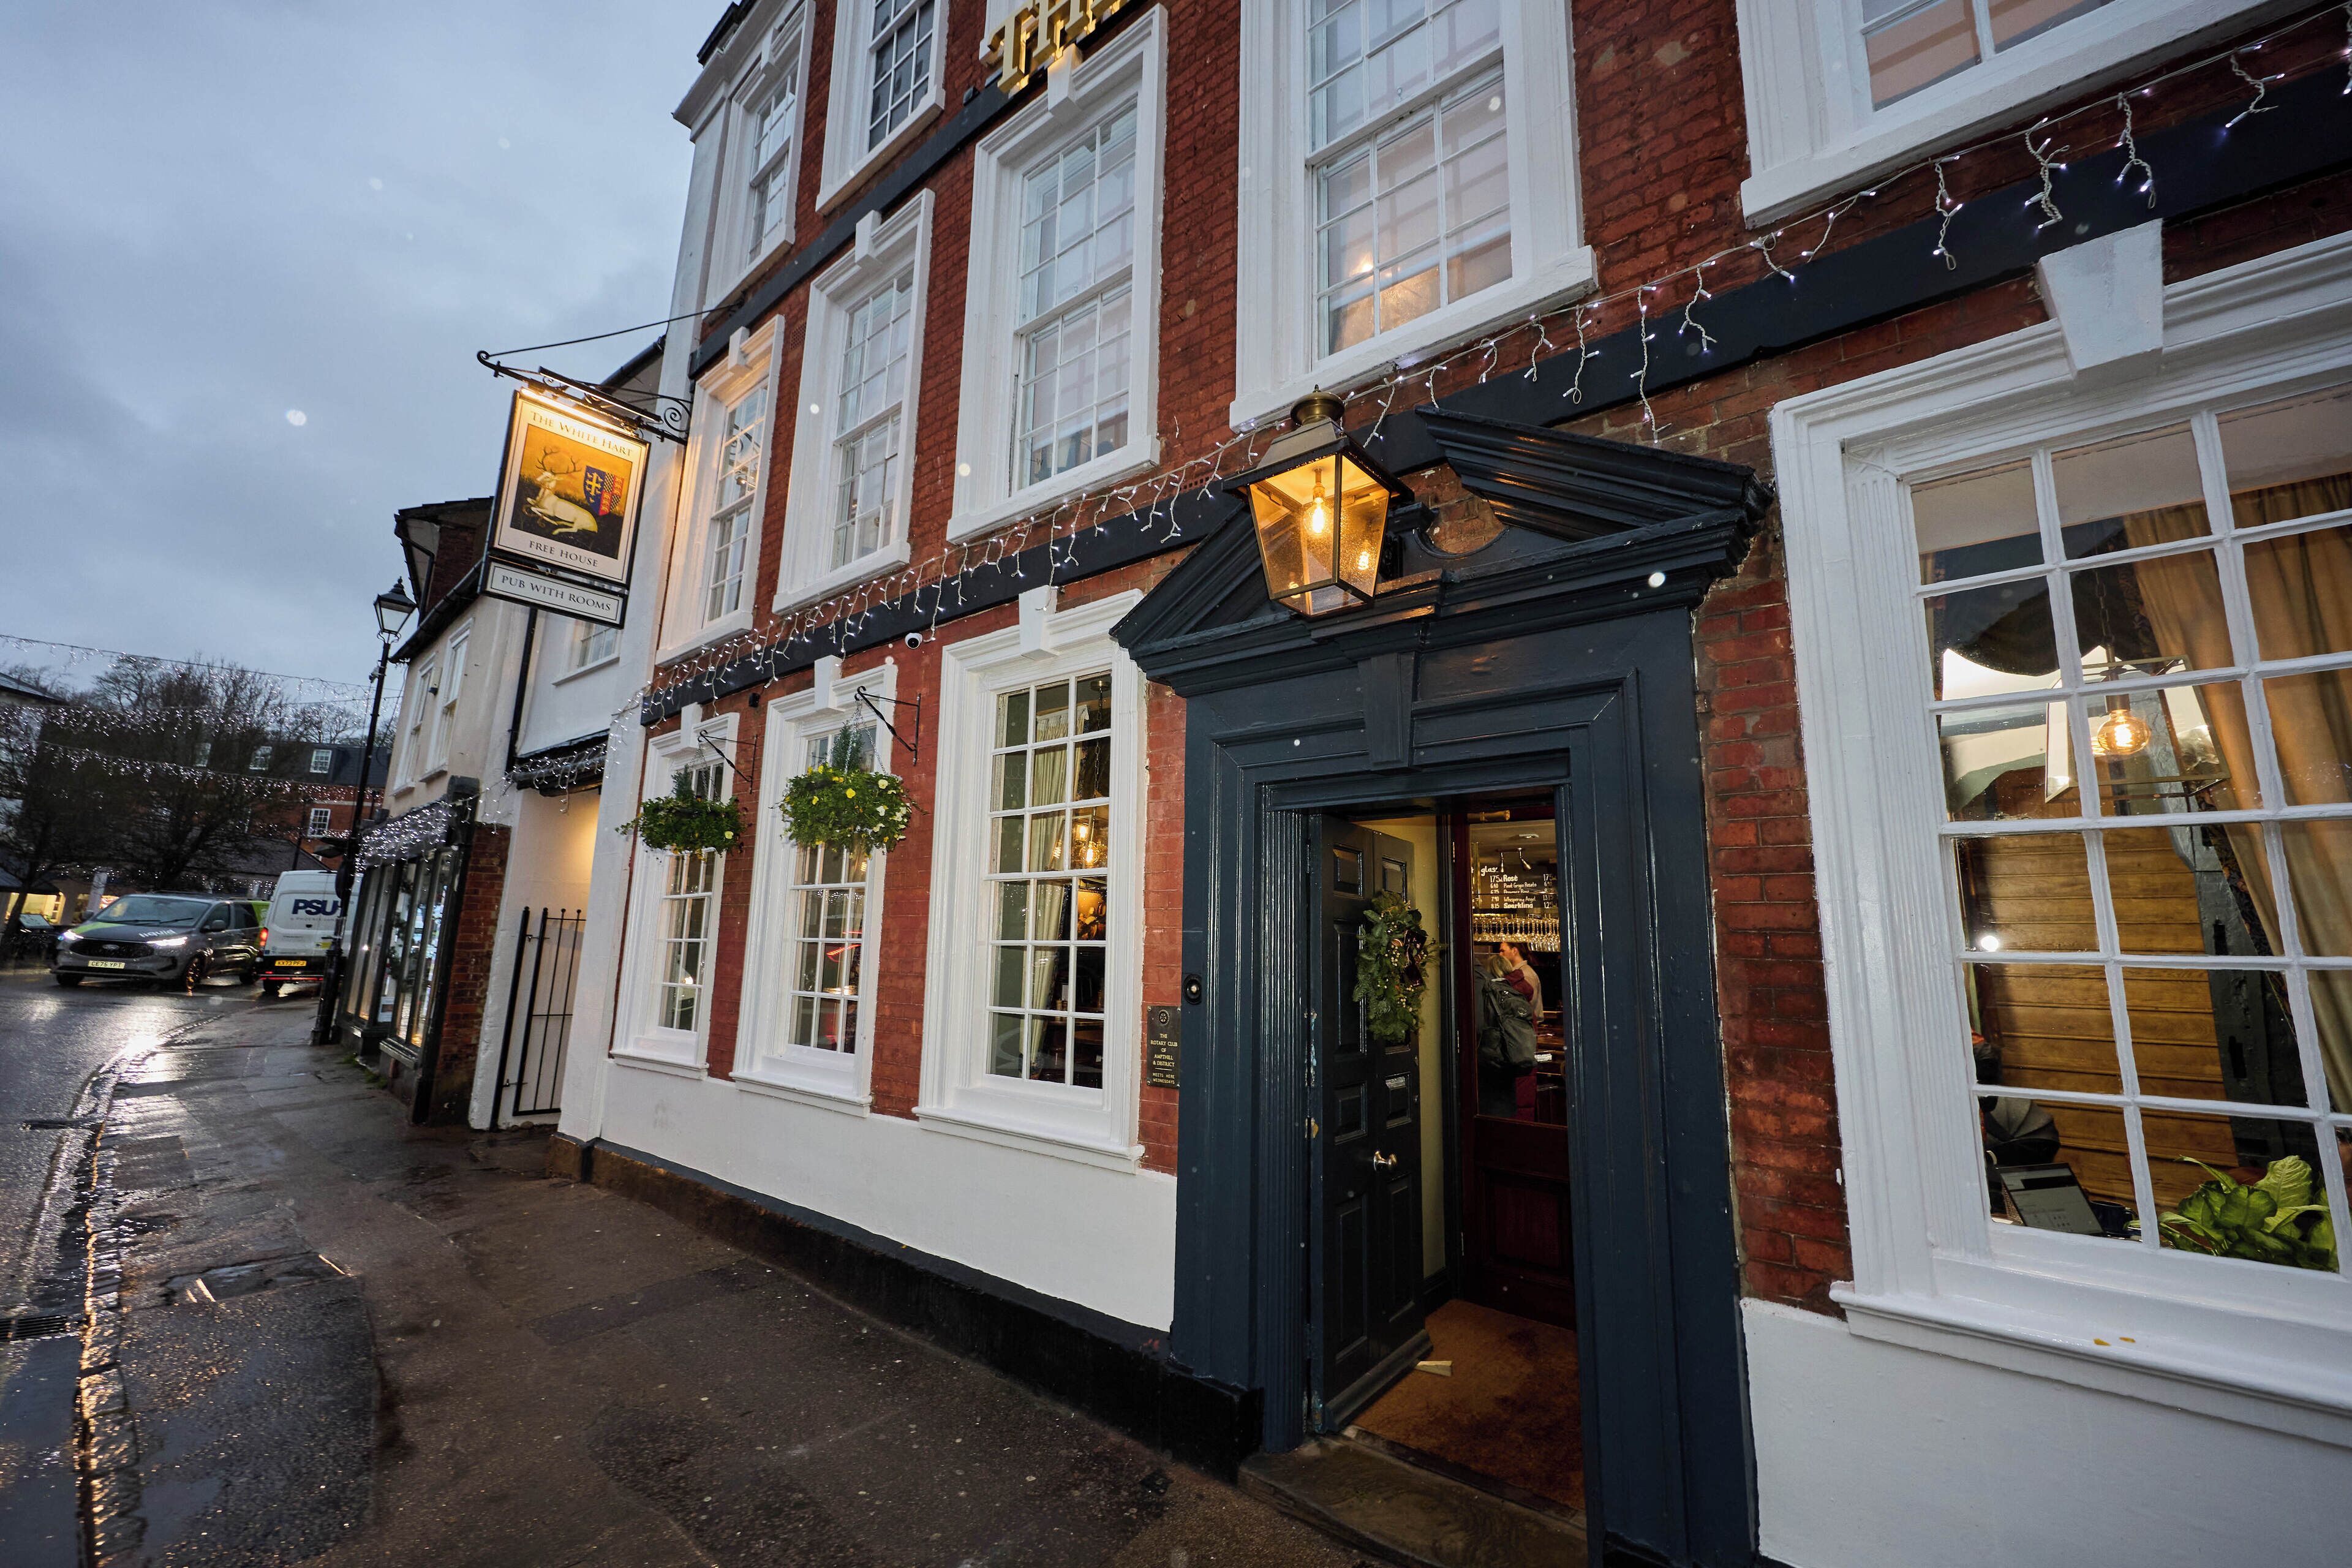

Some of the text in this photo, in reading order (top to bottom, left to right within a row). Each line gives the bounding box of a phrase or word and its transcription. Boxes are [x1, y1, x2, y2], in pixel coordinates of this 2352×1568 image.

[530, 411, 633, 457] THE WHITE HART
[529, 540, 598, 567] FREE HOUSE
[502, 575, 611, 611] PUB WITH ROOMS
[138, 929, 176, 938] liquid
